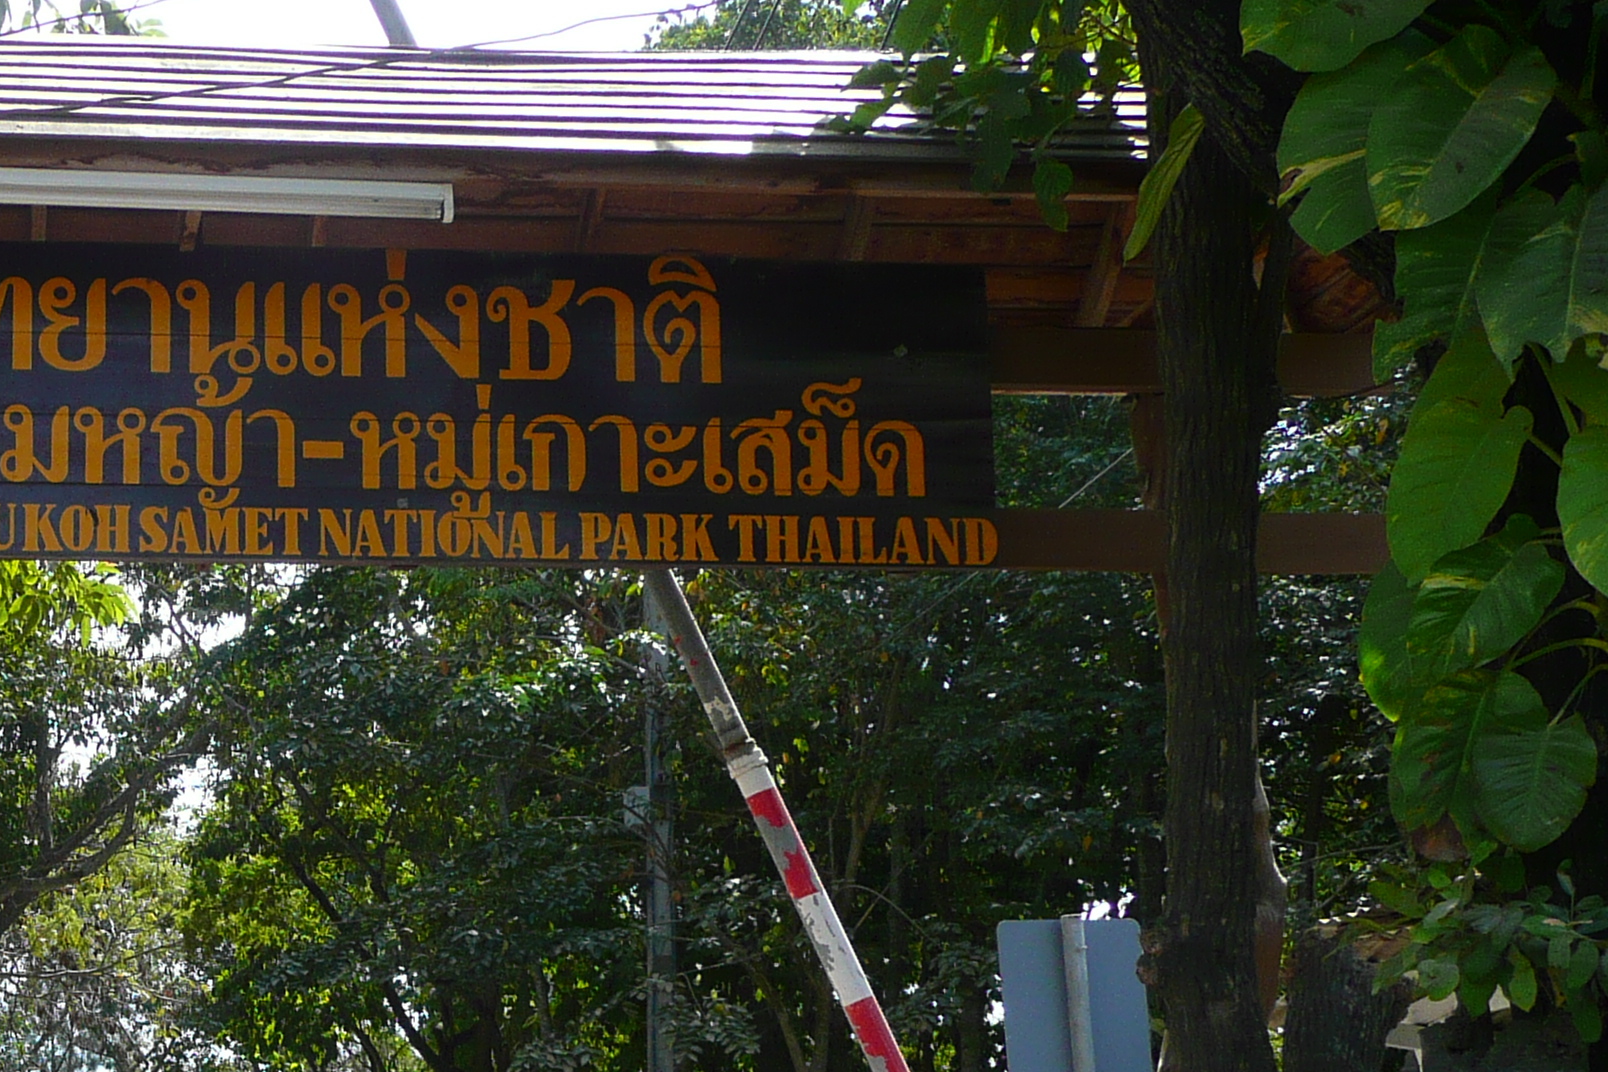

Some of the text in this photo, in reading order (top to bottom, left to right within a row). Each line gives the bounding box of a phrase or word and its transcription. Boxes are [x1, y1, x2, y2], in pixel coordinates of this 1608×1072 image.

[23, 502, 132, 554] KOH
[139, 504, 309, 558] SAMET
[317, 506, 570, 561] NATIONAL
[581, 511, 717, 563] PARK
[728, 513, 1000, 567] THAILAND
